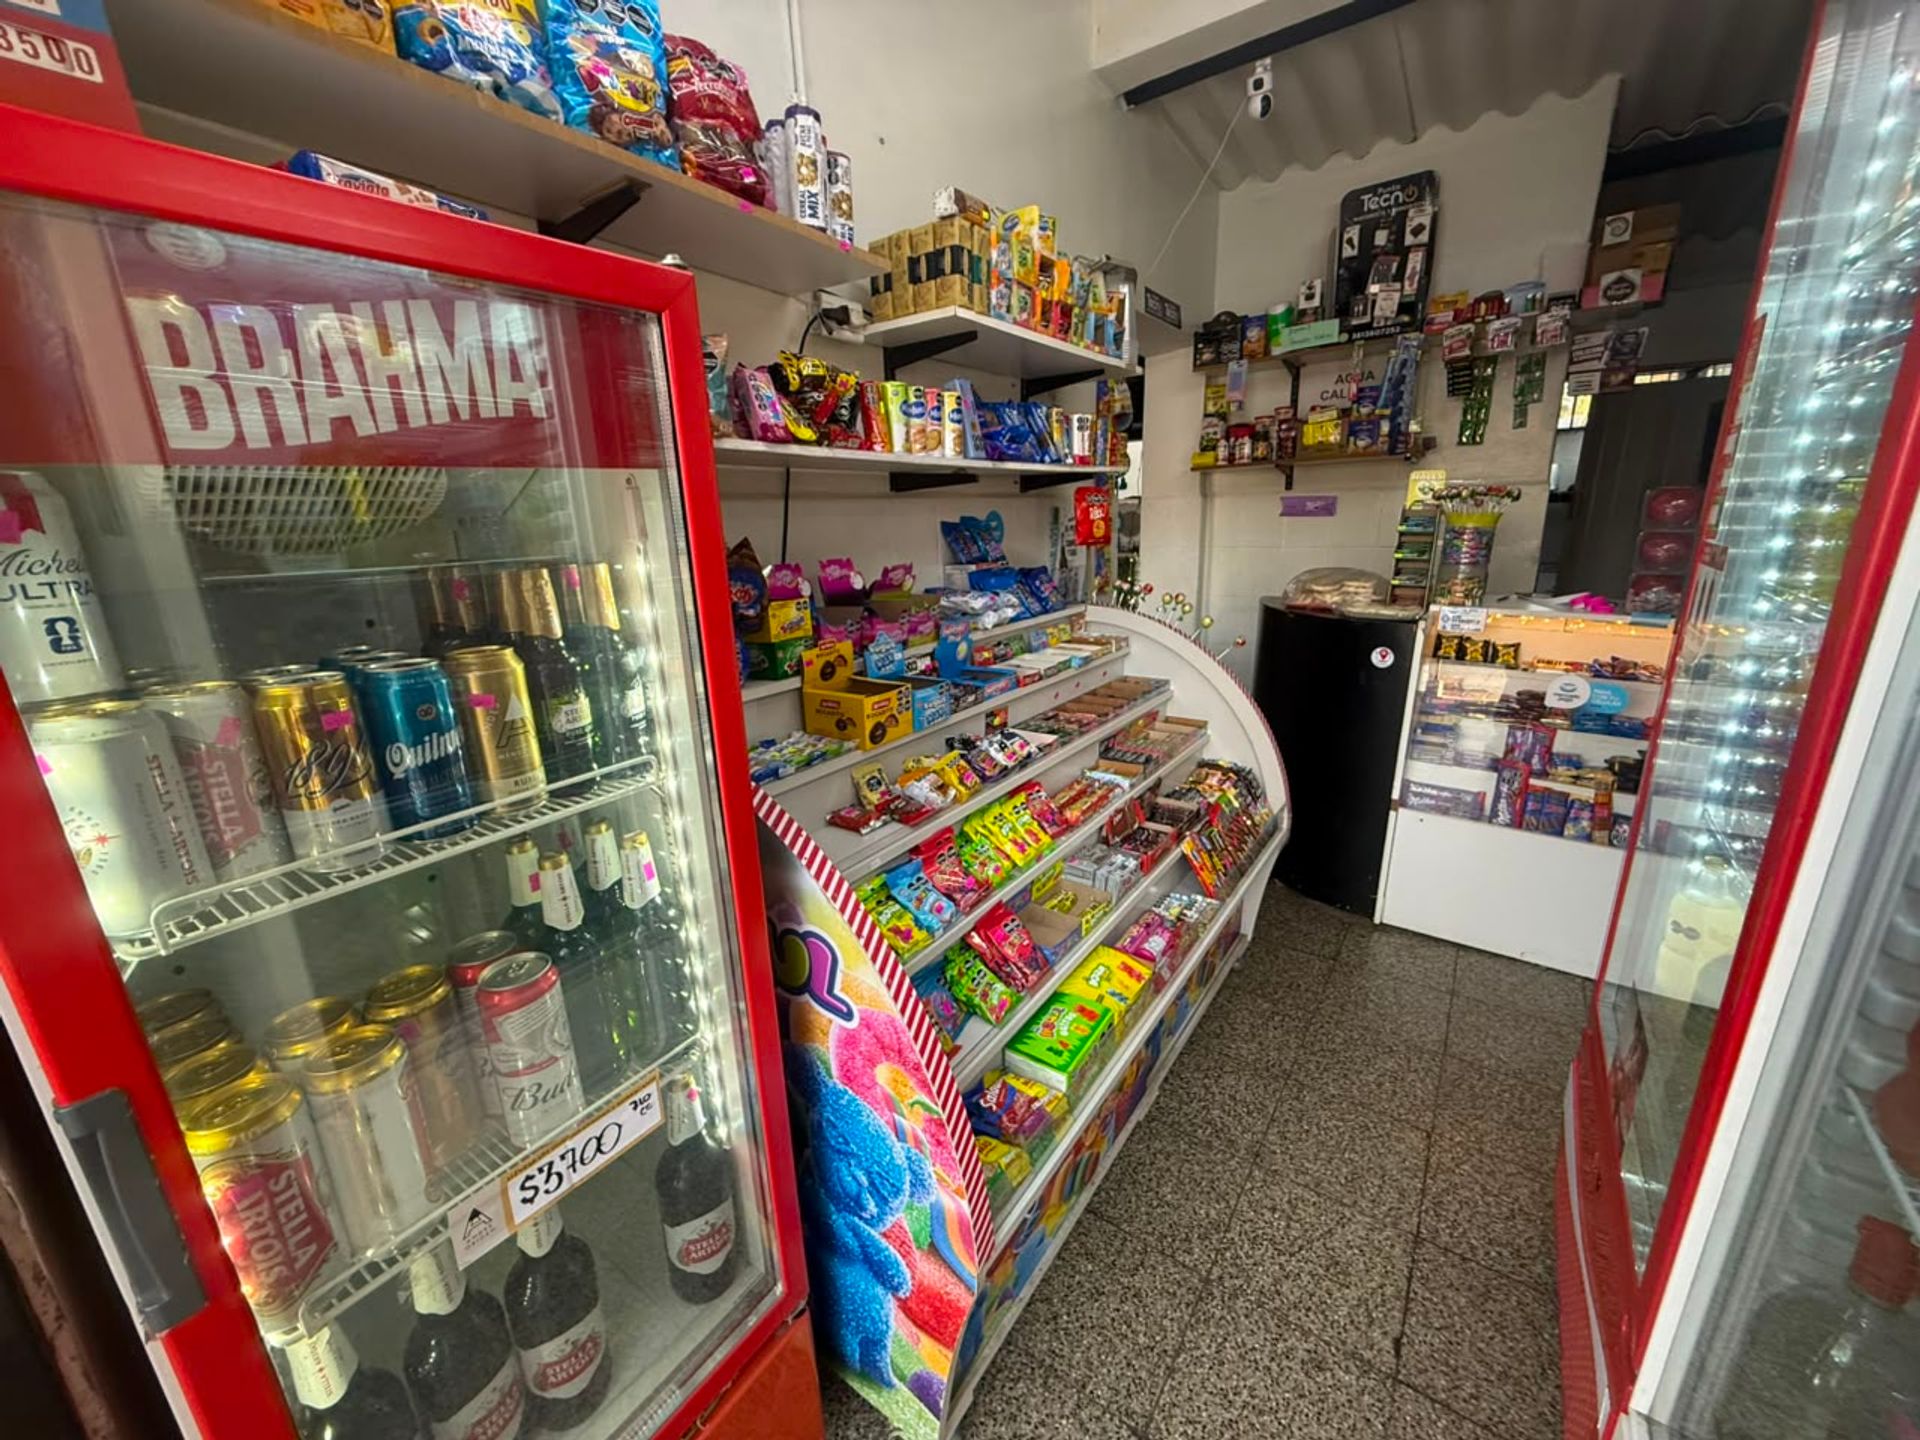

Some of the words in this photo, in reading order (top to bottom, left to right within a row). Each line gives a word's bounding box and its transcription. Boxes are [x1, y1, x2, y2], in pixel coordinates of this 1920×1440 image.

[336, 177, 391, 198] raviata
[807, 190, 820, 220] MIX
[130, 299, 547, 450] BRAHMA
[385, 725, 463, 780] Quilm
[145, 754, 175, 814] STELLA
[204, 759, 247, 843] STELLA
[518, 1121, 623, 1205] $3700
[268, 1168, 318, 1271] STELLA
[545, 1338, 595, 1376] STELLA
